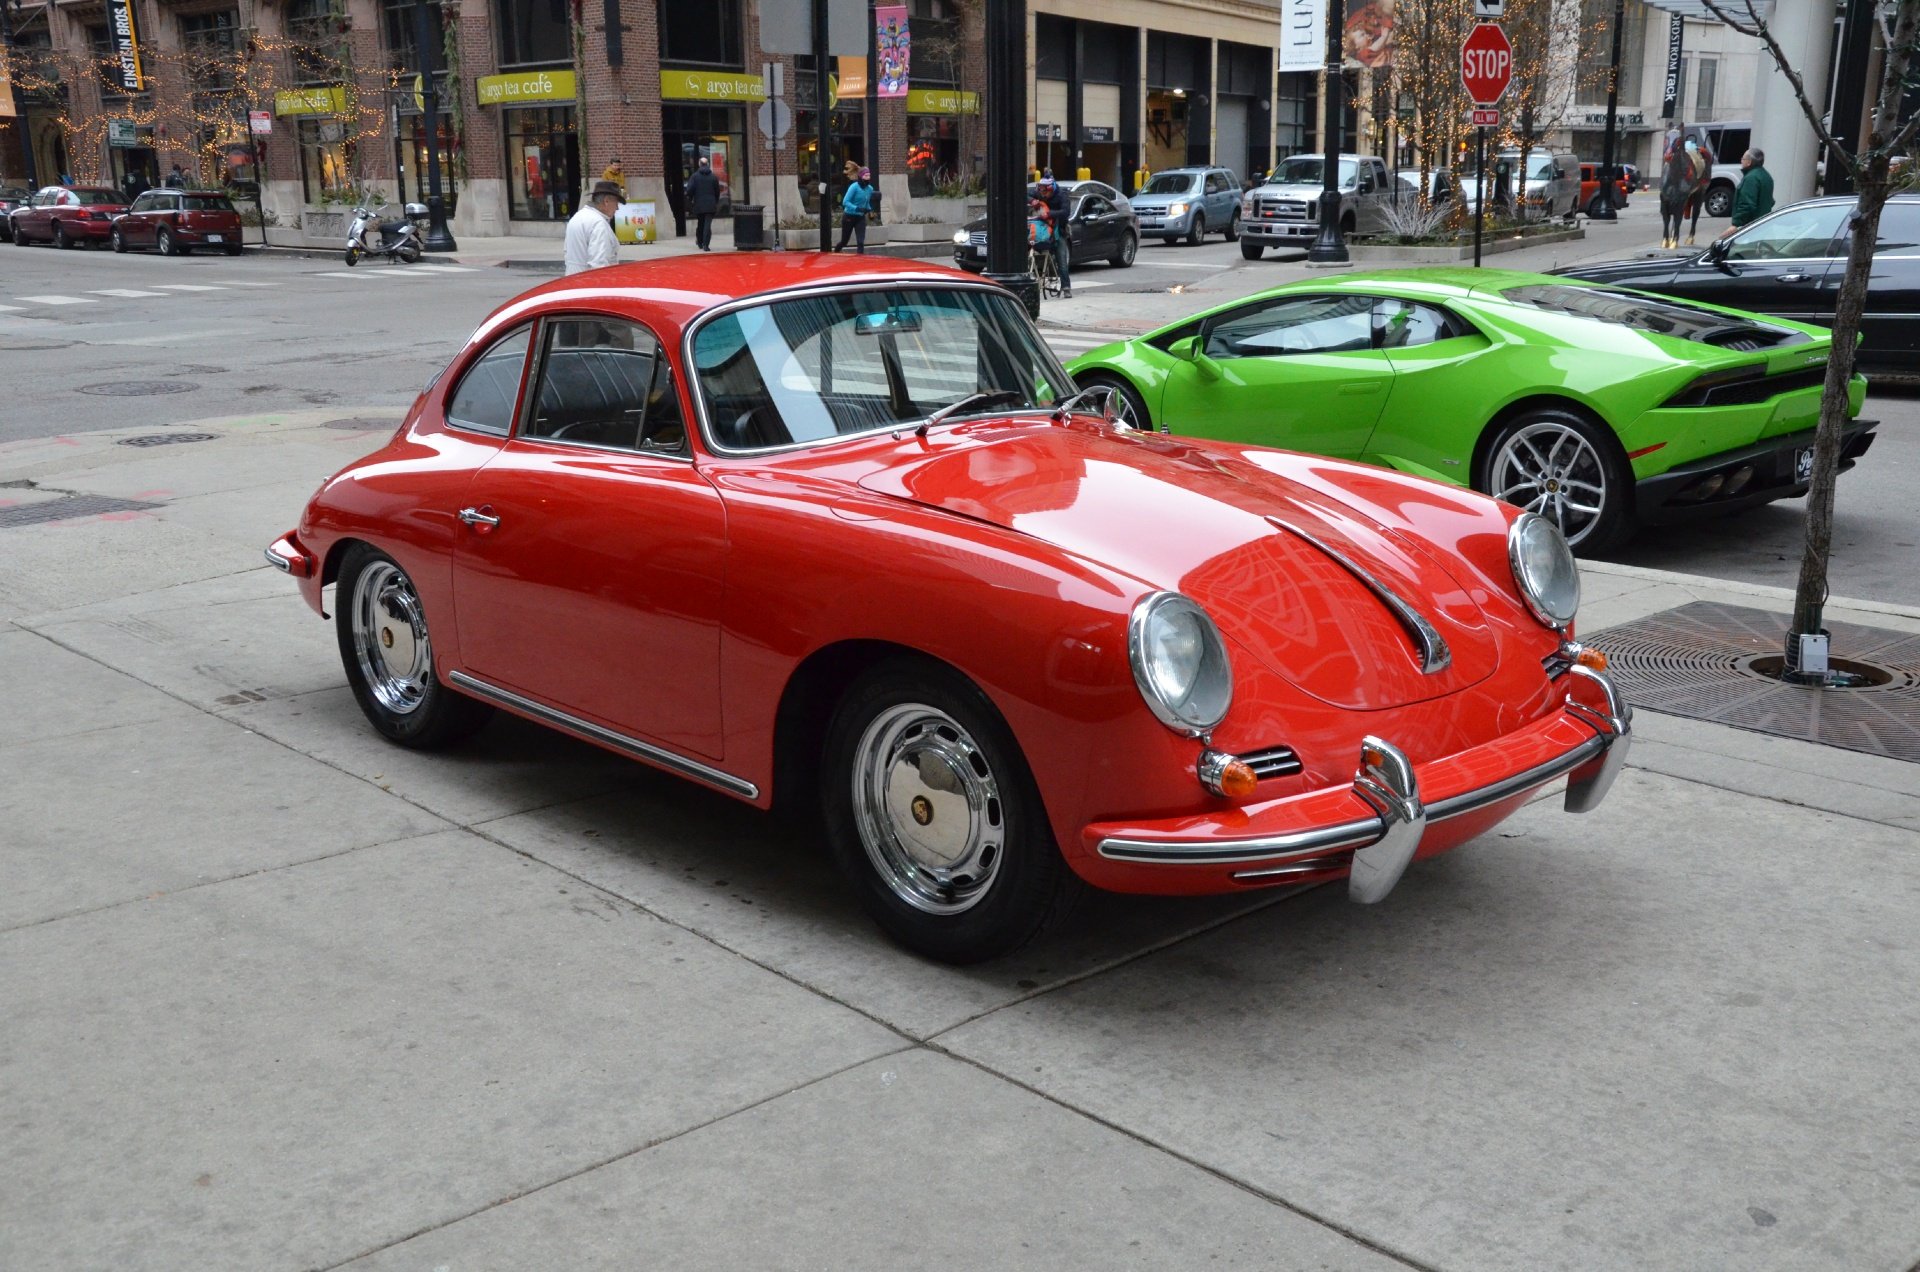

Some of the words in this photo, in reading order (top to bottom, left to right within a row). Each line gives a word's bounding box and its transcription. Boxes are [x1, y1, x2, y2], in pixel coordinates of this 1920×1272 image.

[114, 7, 130, 35] BROS.
[1465, 49, 1509, 79] STOP
[487, 84, 502, 99] argo
[505, 81, 519, 95] tea
[522, 73, 553, 94] café
[707, 80, 732, 98] argo
[735, 80, 748, 95] tea
[1665, 73, 1677, 102] rack
[1474, 113, 1485, 123] ALL
[1486, 113, 1497, 123] WAY
